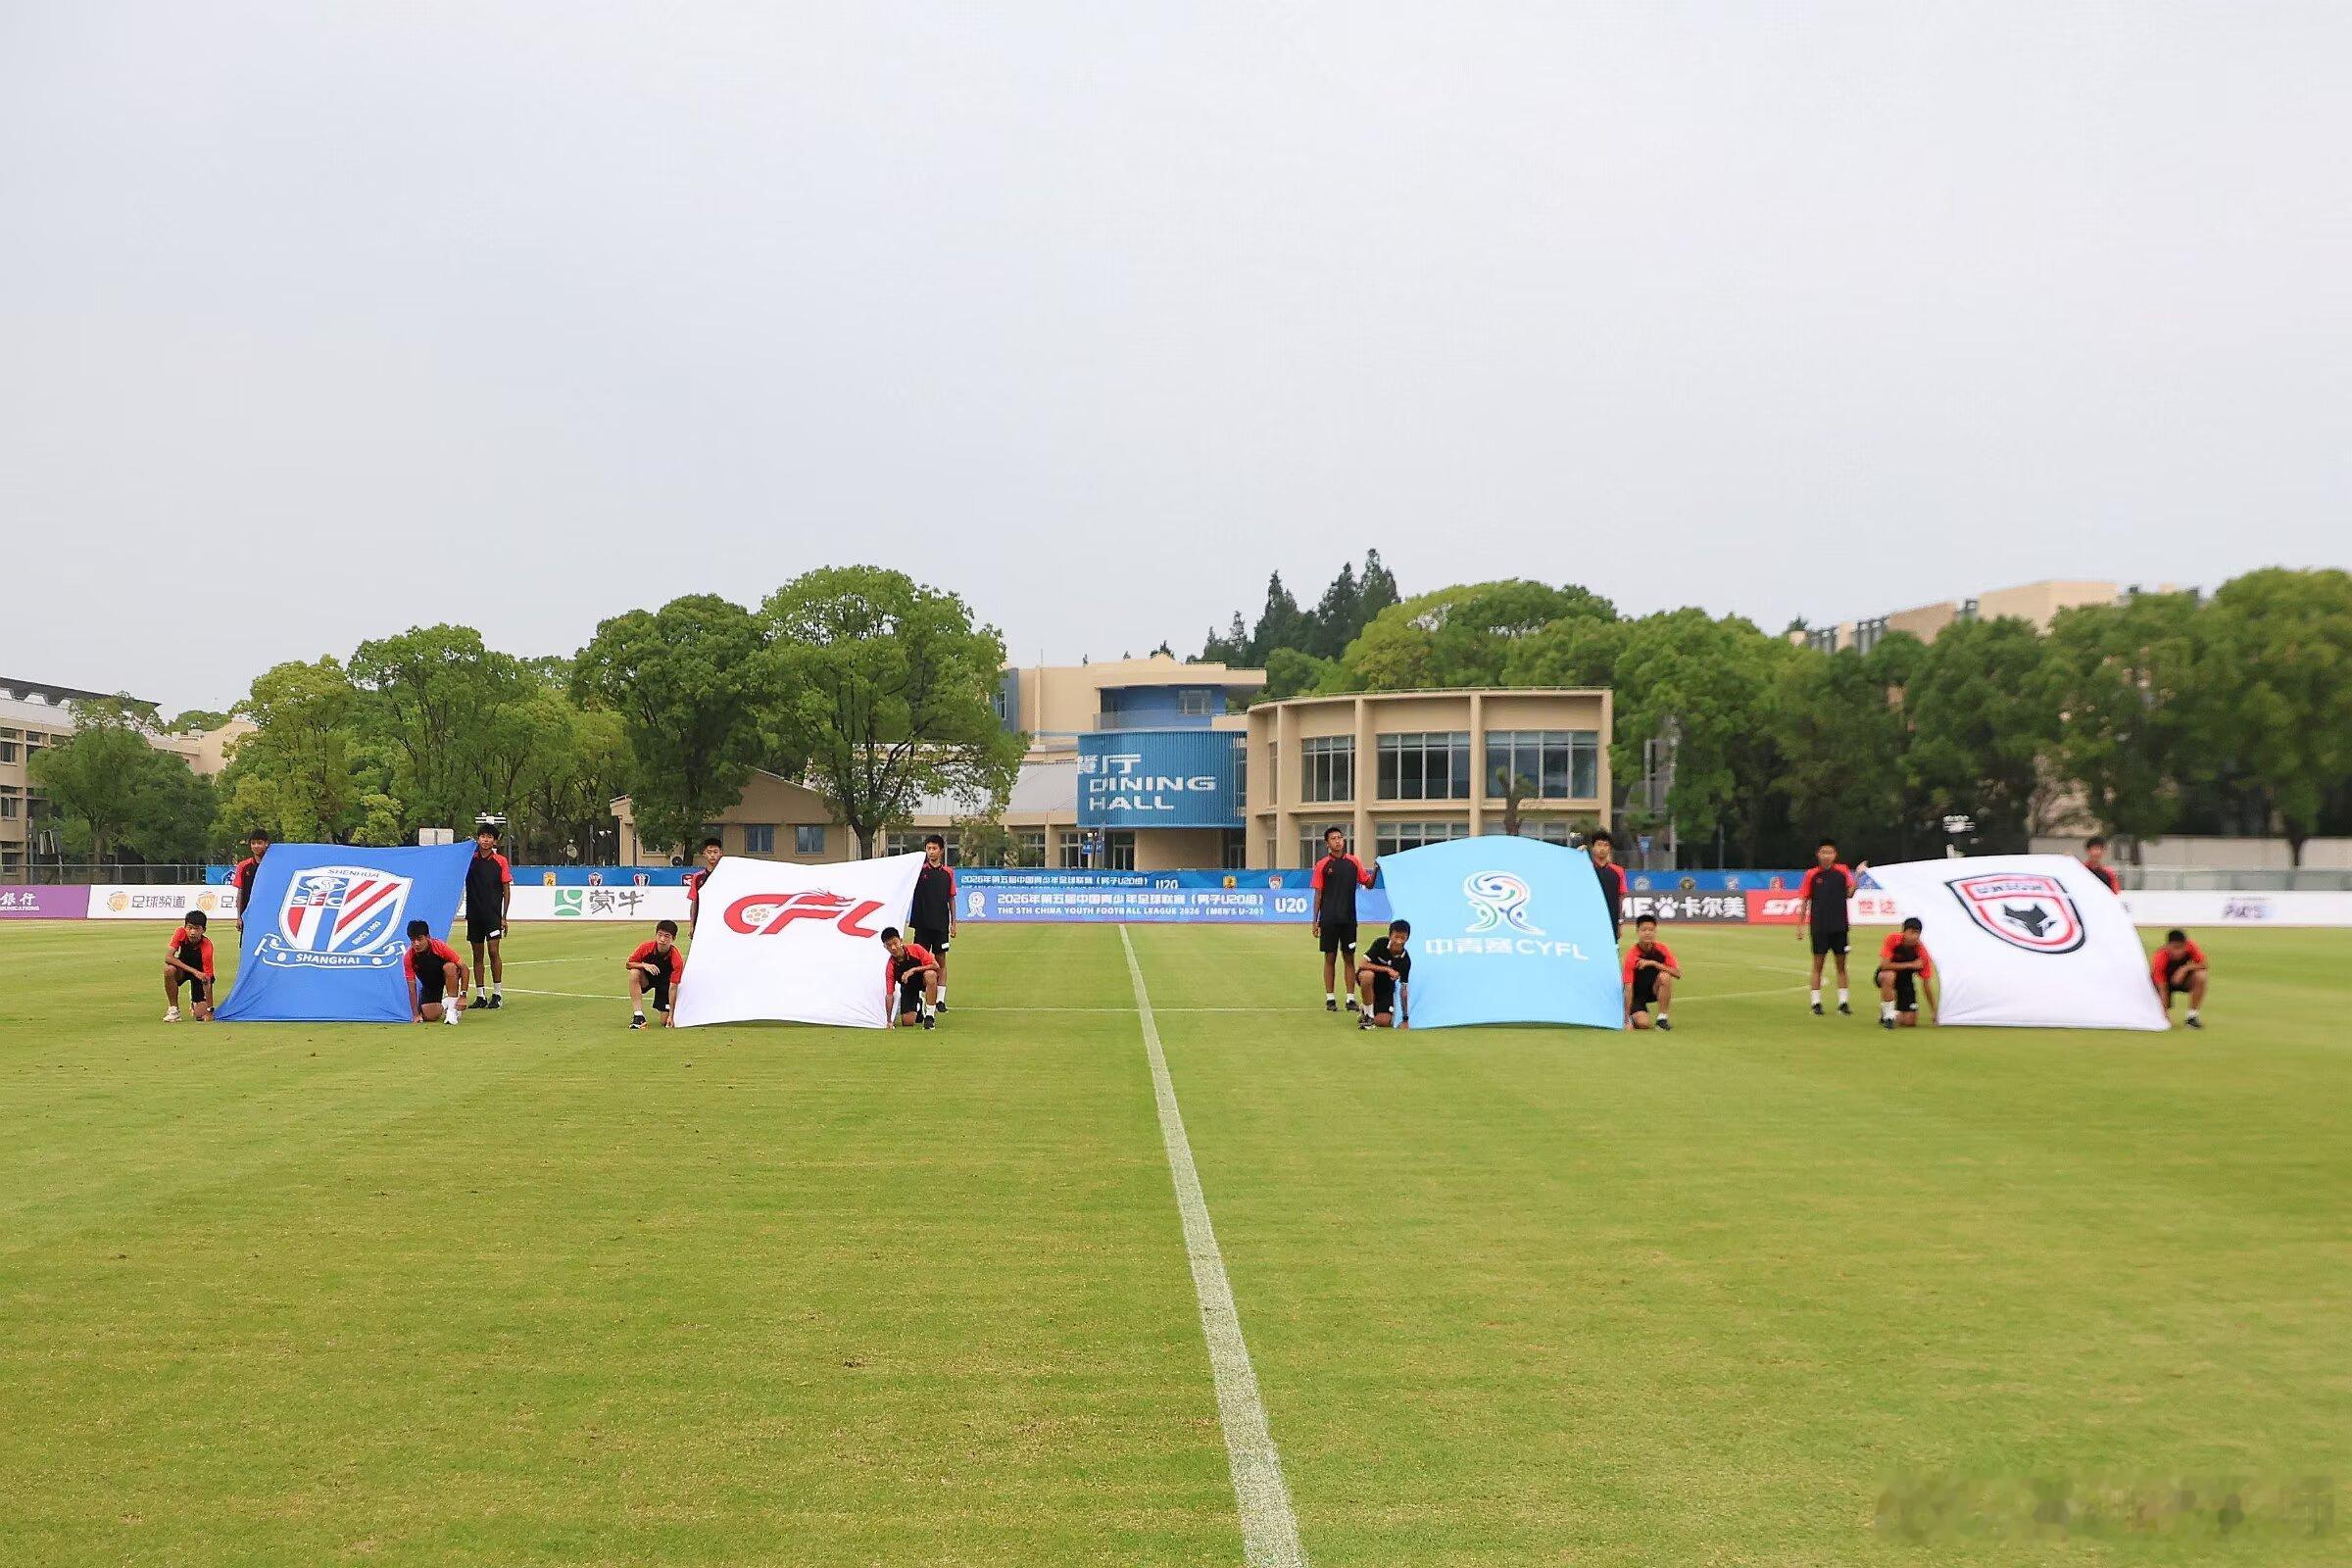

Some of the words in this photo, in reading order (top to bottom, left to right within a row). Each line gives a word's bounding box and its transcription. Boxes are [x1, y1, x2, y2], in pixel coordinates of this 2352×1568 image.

[1089, 776, 1215, 792] DINING
[1089, 795, 1174, 810] HALL
[327, 868, 379, 878] SHENHUA
[292, 896, 342, 906] SFC
[589, 890, 645, 916] 蒙牛
[1274, 897, 1308, 914] U20
[1680, 896, 1745, 919] 卡尔美
[723, 891, 885, 938] CFL
[997, 906, 1014, 915] THE
[1035, 906, 1062, 915] CHINA
[1063, 906, 1095, 916] YOUTH
[1096, 906, 1142, 916] FOOTBALL
[1144, 906, 1177, 916] LEAGUE
[1179, 906, 1200, 916] 2026
[295, 954, 360, 965] SHANGHAI
